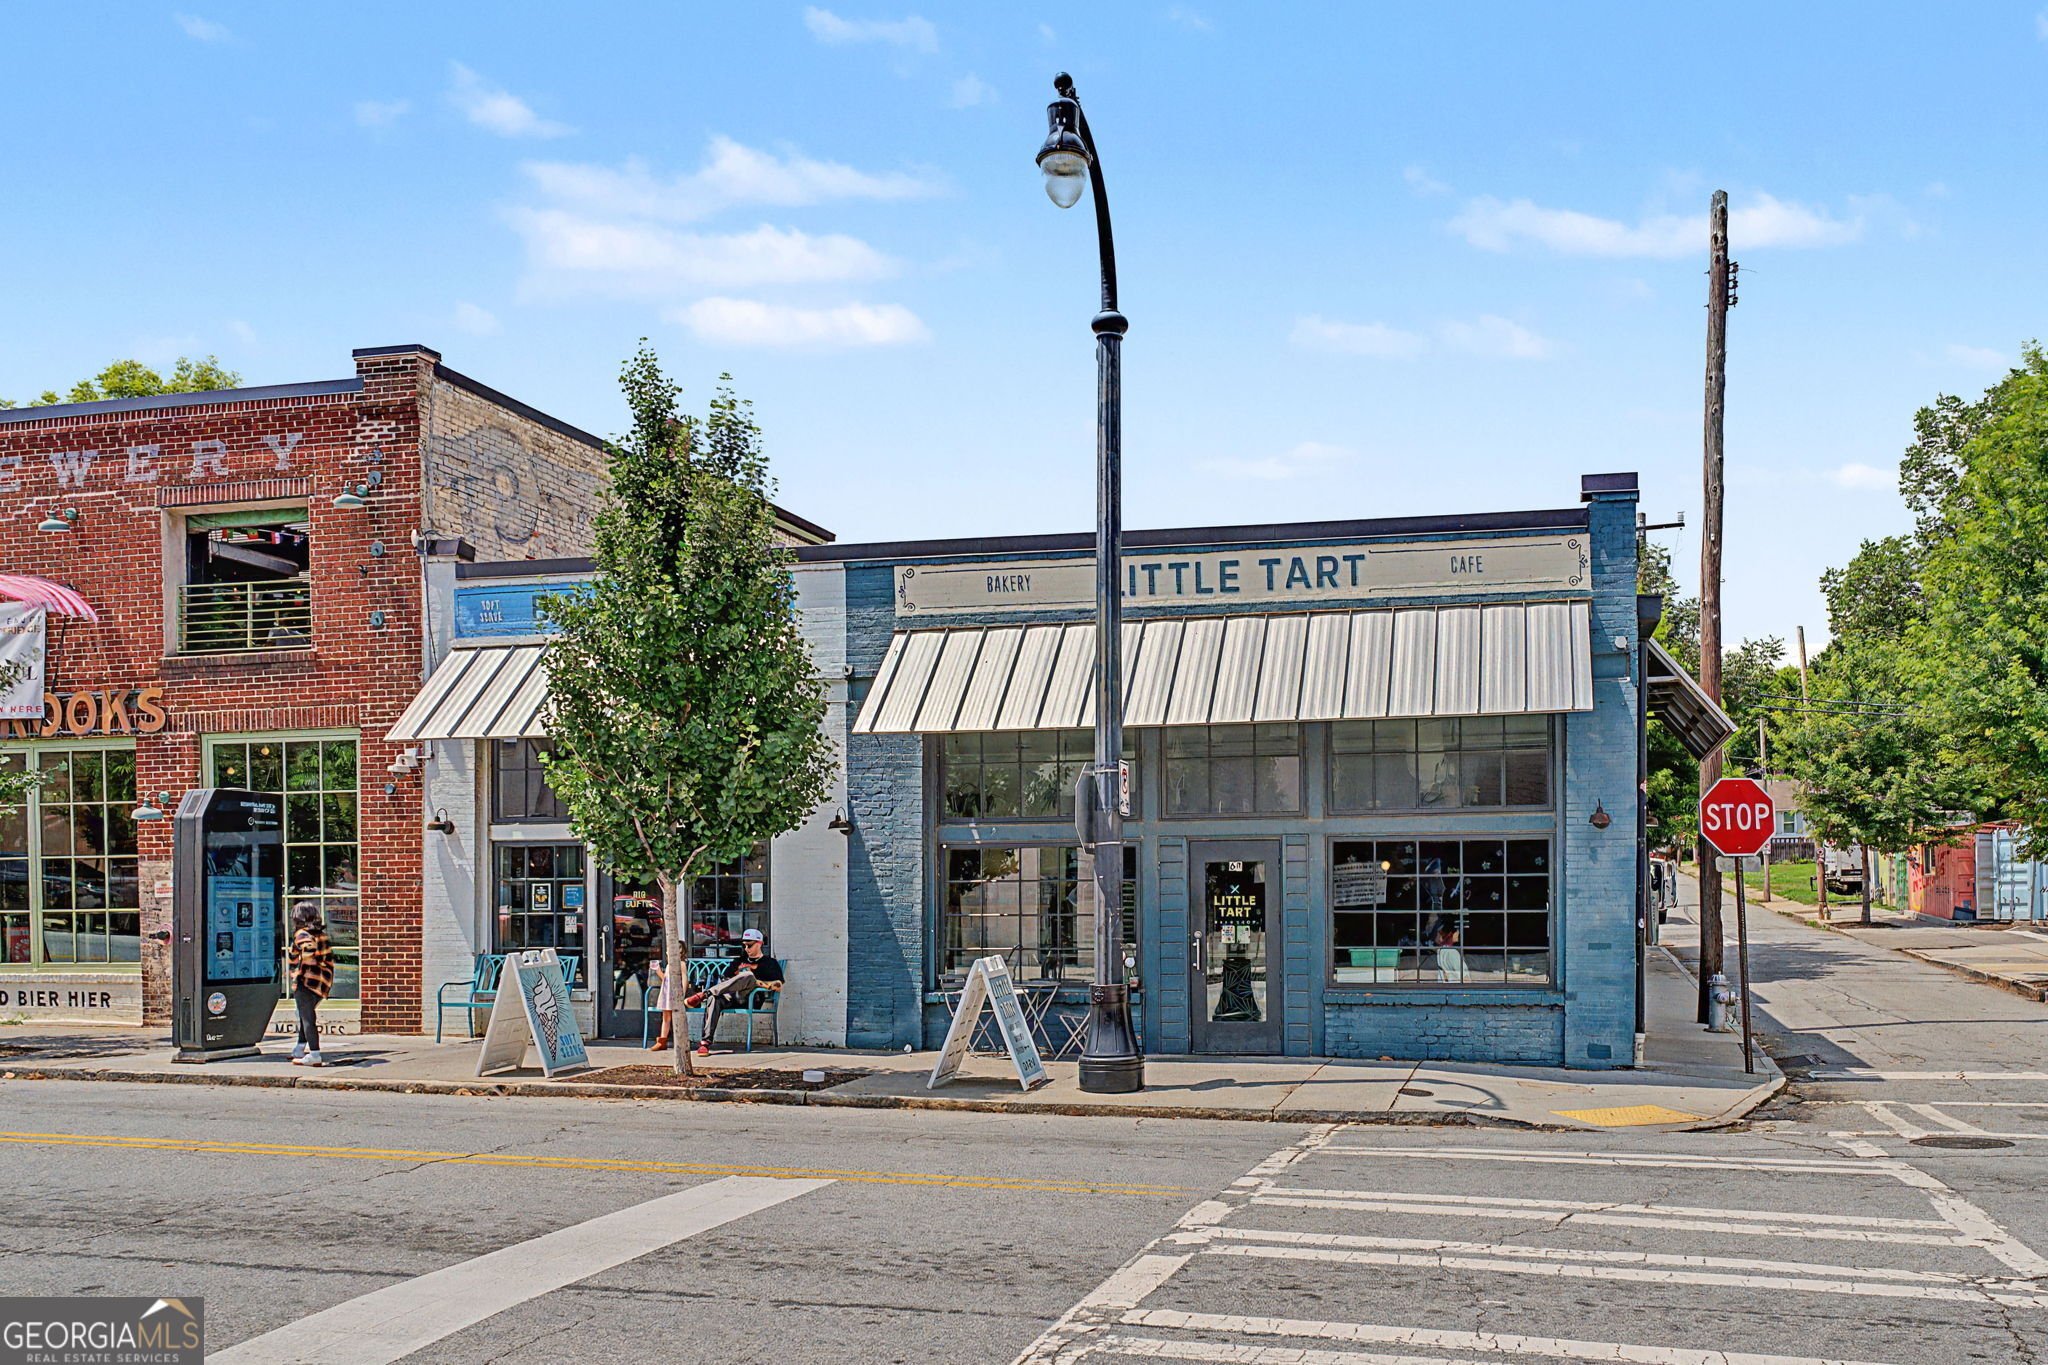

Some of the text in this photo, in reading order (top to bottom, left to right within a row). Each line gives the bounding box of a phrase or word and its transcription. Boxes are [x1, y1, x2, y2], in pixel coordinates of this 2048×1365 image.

[1450, 555, 1484, 574] CAFE
[987, 574, 1031, 593] BAKERY
[1120, 553, 1366, 597] ITTLE TART
[481, 599, 500, 611] SOFT
[10, 705, 42, 713] HERE
[1706, 803, 1770, 831] STOP
[1213, 895, 1257, 906] LITTLE
[1219, 907, 1252, 918] TART
[18, 990, 59, 1007] BIER
[68, 991, 111, 1008] HIER
